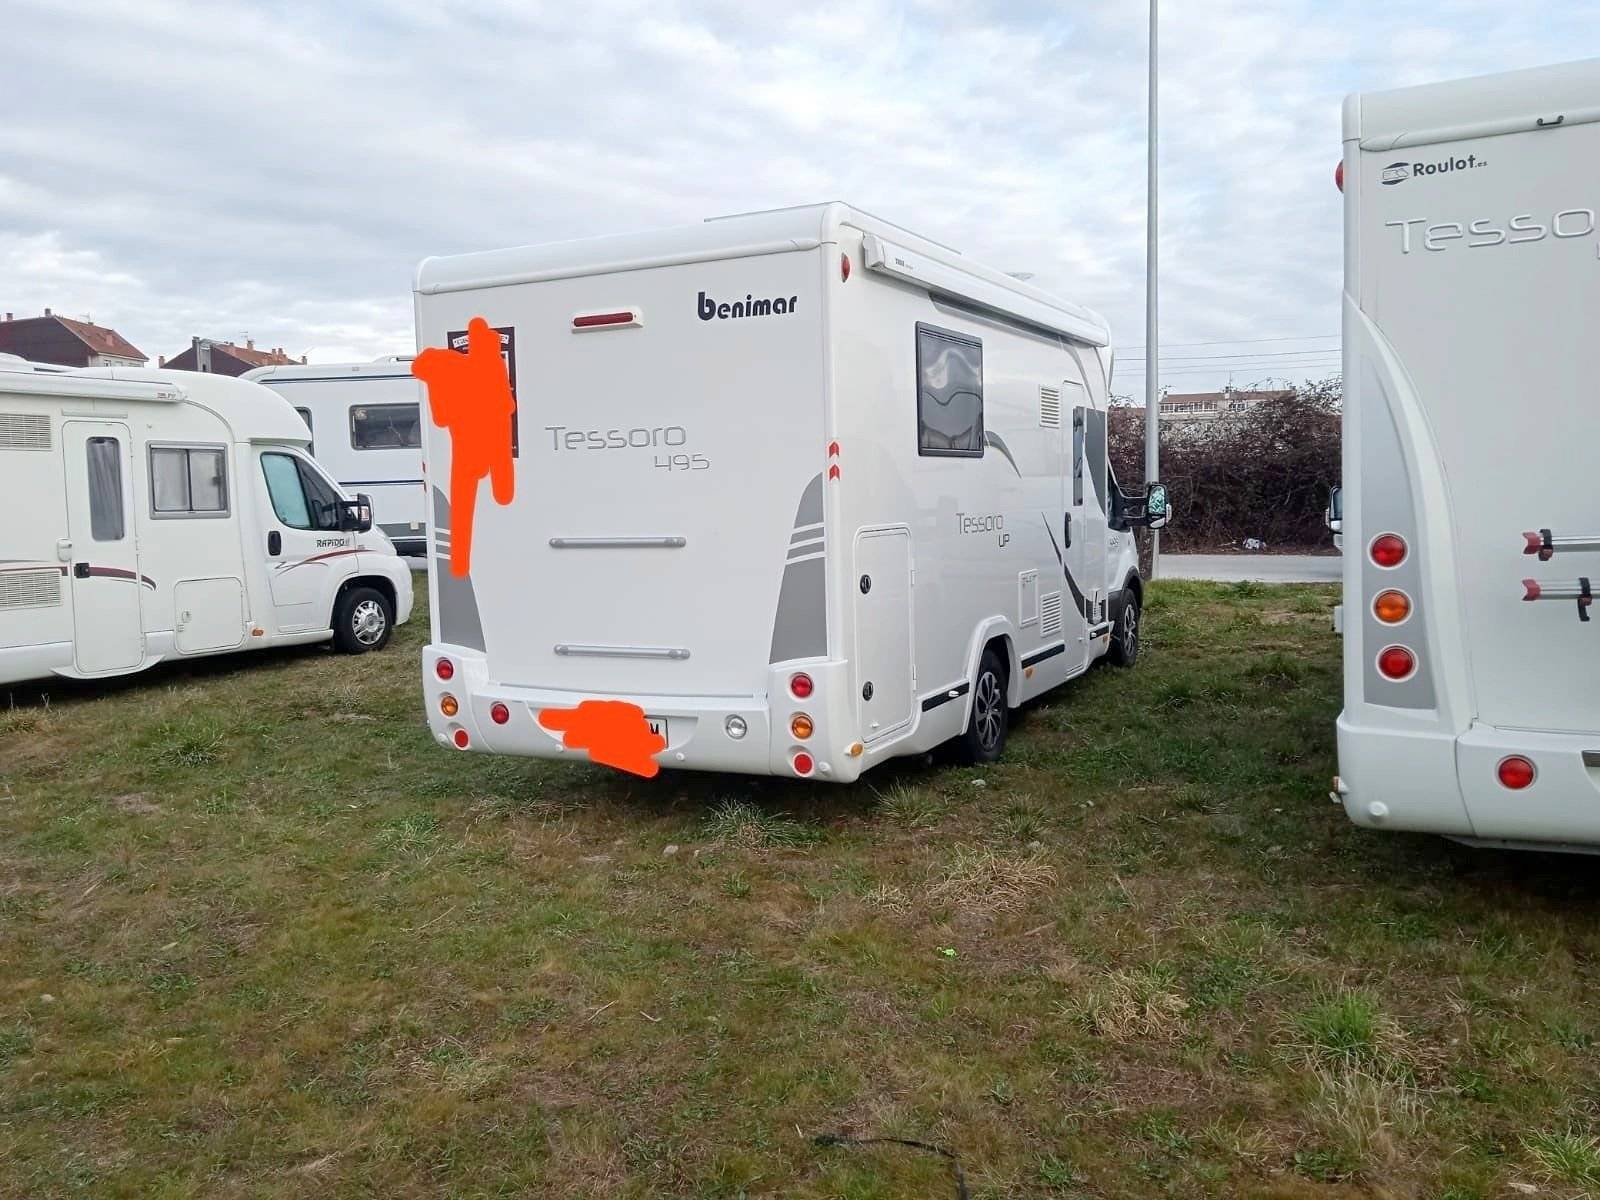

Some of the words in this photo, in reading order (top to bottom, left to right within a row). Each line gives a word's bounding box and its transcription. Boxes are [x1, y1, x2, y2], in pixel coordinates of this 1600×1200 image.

[698, 291, 798, 321] benimar
[545, 426, 687, 451] Tessoro
[654, 454, 710, 472] 495
[956, 512, 1004, 535] Tessoro
[316, 538, 345, 548] RAPIDO
